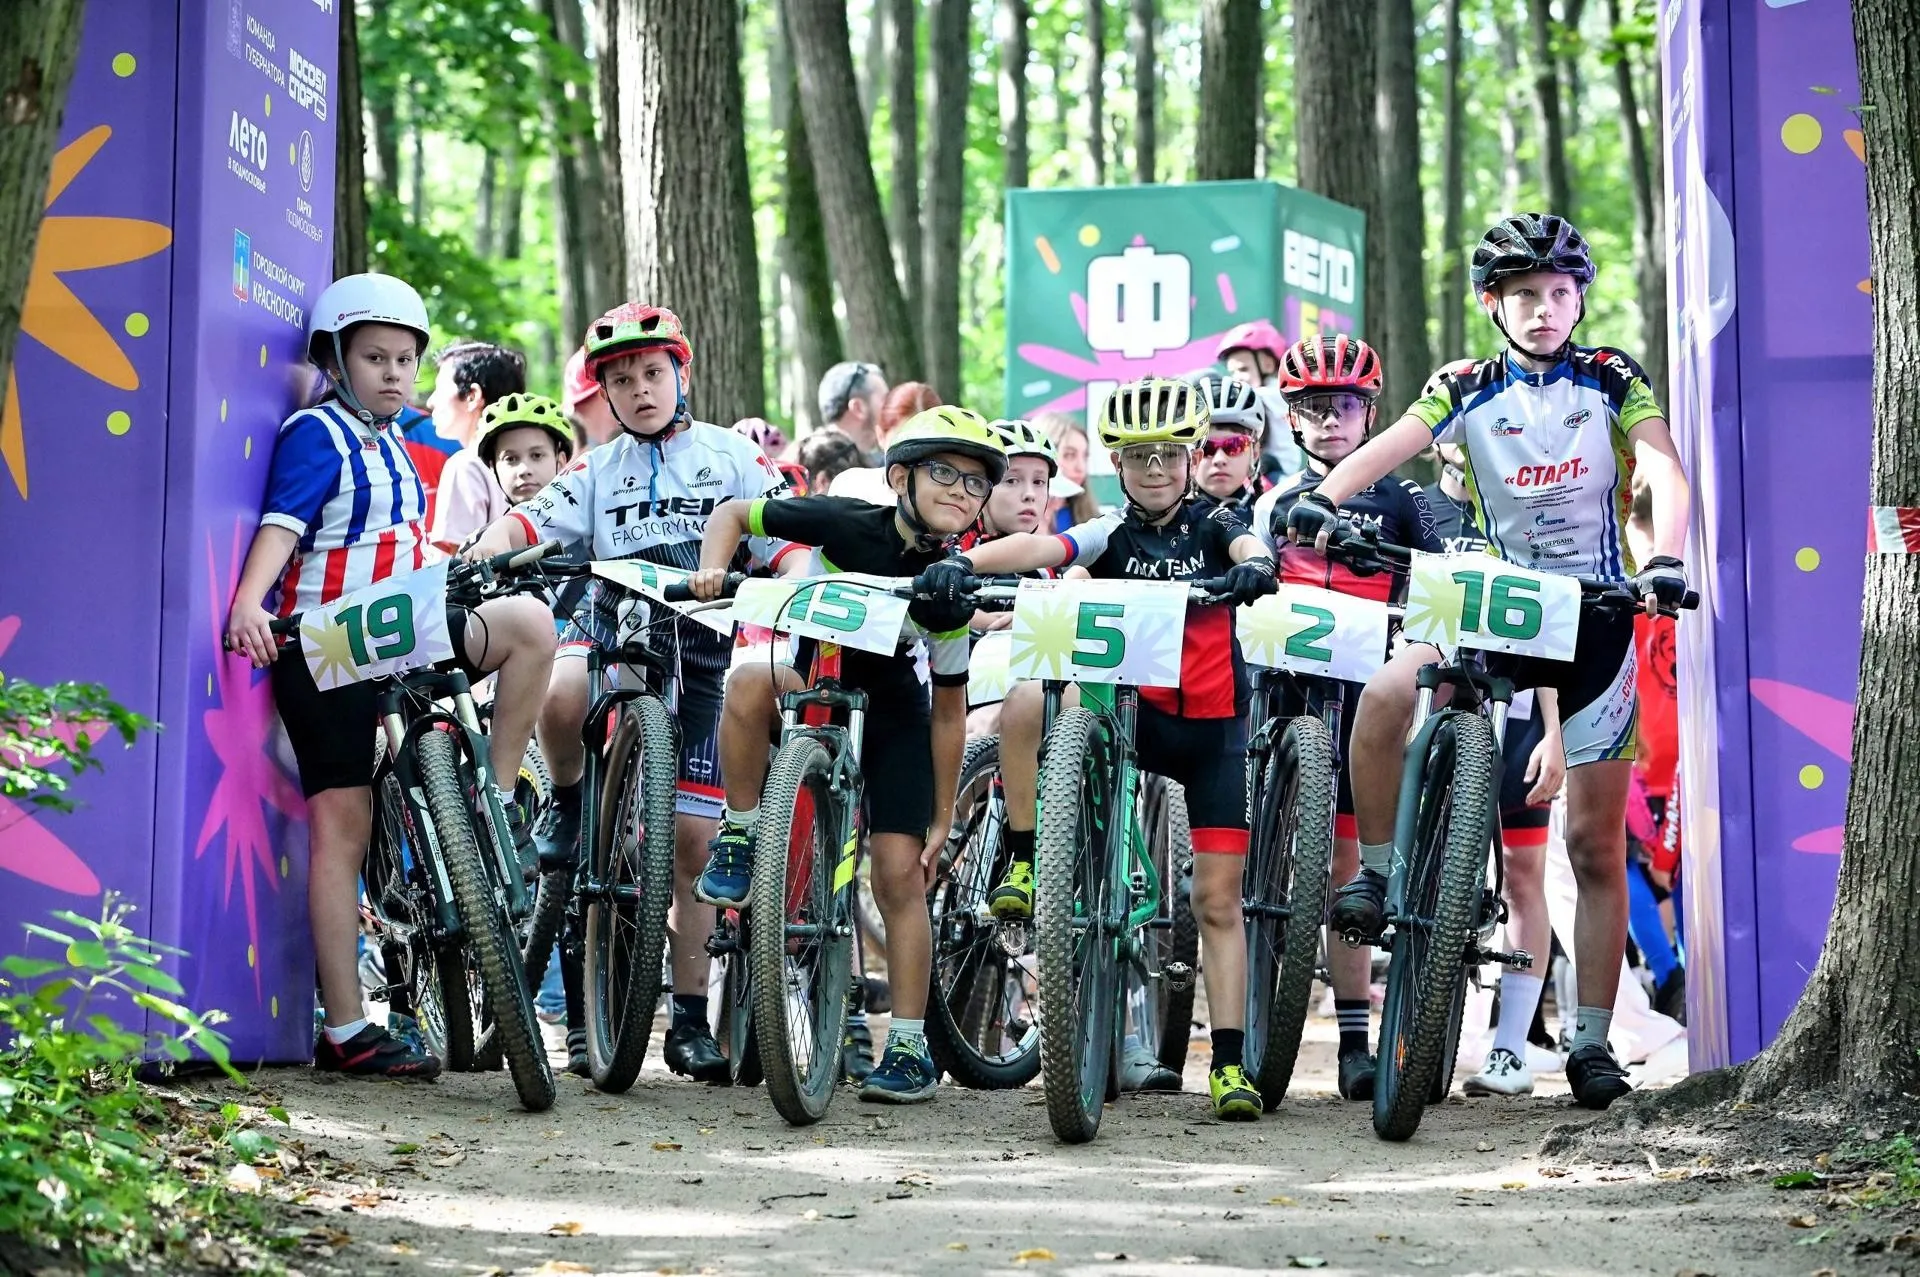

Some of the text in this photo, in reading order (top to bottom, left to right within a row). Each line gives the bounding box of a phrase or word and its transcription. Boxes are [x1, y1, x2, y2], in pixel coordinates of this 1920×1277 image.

[246, 14, 276, 53] КОМАНДА
[245, 43, 285, 88] ГУБЕРНАТОРА
[285, 207, 323, 243] ПОДМОСКОВЬЯ
[296, 197, 313, 218] ПАРКИ
[253, 251, 306, 299] ГОРОДСКОЙ ОКРУГ
[1283, 228, 1356, 304] ВЕЛО
[252, 280, 304, 331] КРАСНОГОРСК
[1087, 246, 1191, 360] Ф
[1504, 457, 1589, 487] «СТАРТ»
[612, 519, 681, 547] FACTORY
[1540, 537, 1575, 548] СБЕРБАНК
[1543, 550, 1579, 559] ГАЗПРОМБАНК
[1165, 550, 1206, 577] TEAM
[787, 579, 871, 632] 15
[1451, 570, 1543, 640] 16
[334, 593, 416, 667] 19
[1071, 602, 1126, 668] 5
[1285, 603, 1335, 662] 2
